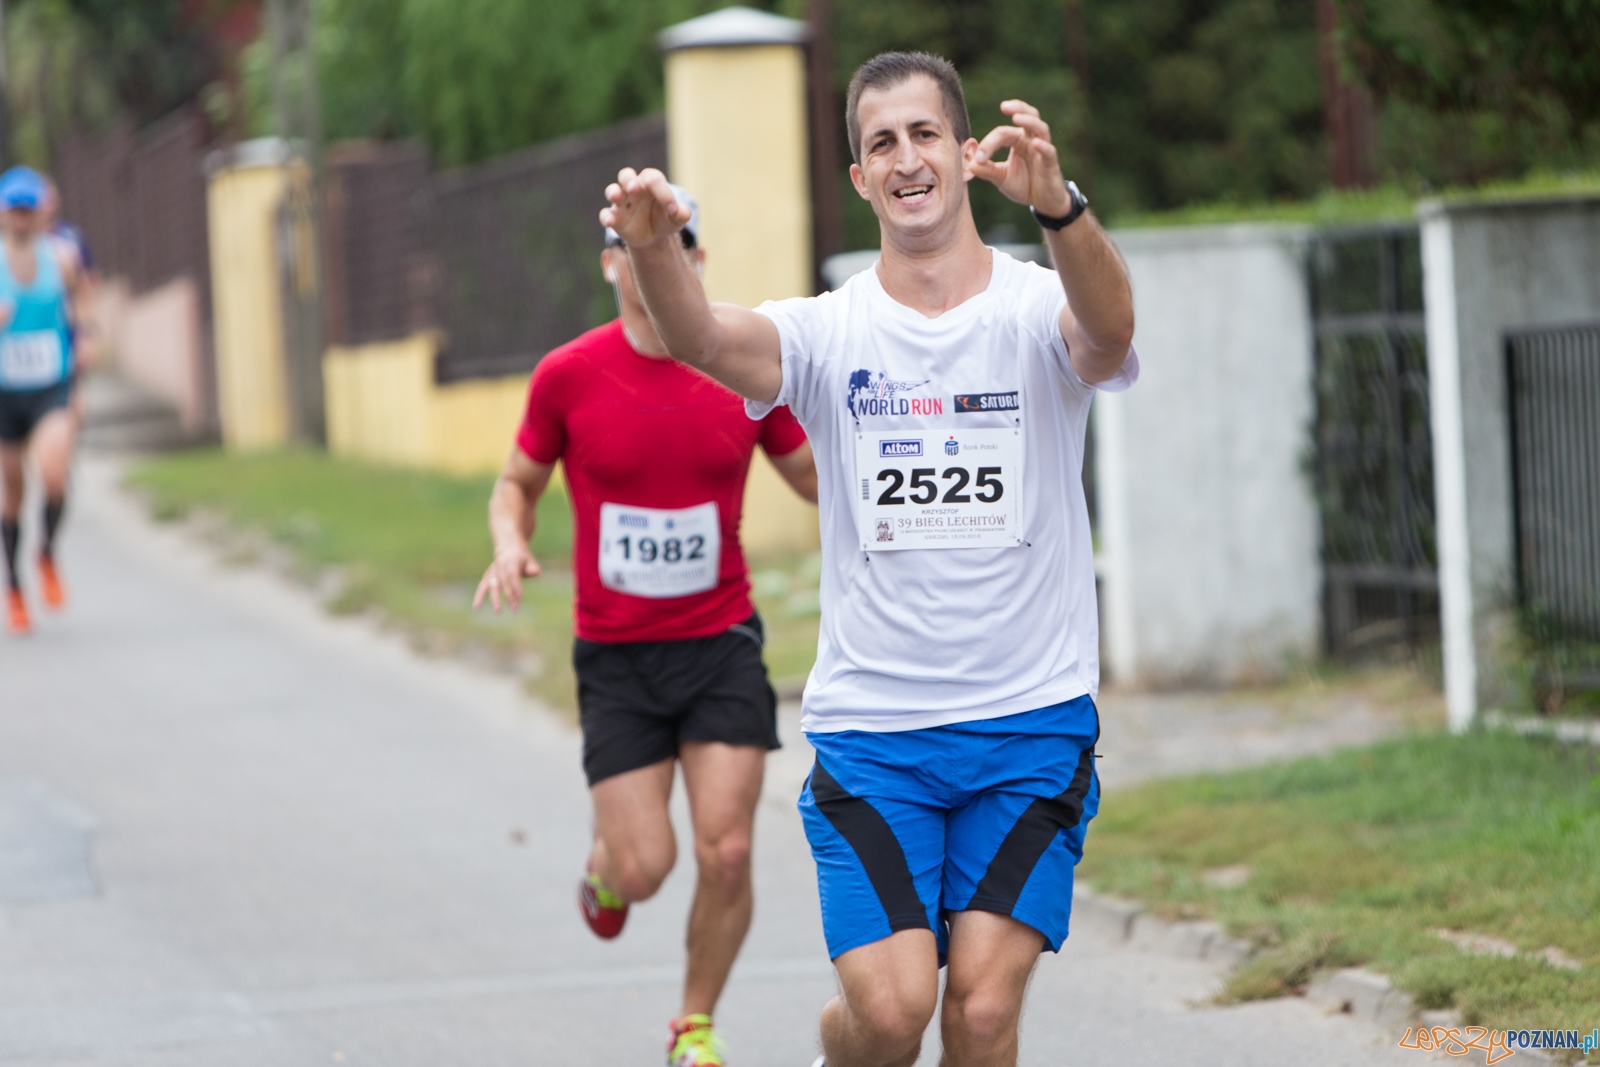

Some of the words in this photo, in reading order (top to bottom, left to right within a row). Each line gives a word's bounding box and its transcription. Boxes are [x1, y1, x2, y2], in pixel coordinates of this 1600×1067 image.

[858, 398, 909, 416] WORLD
[911, 397, 943, 415] RUN
[876, 466, 1004, 505] 2525
[897, 517, 912, 528] 39
[915, 516, 944, 528] BIEG
[947, 513, 1007, 527] LECHITÓW
[617, 534, 705, 563] 1982
